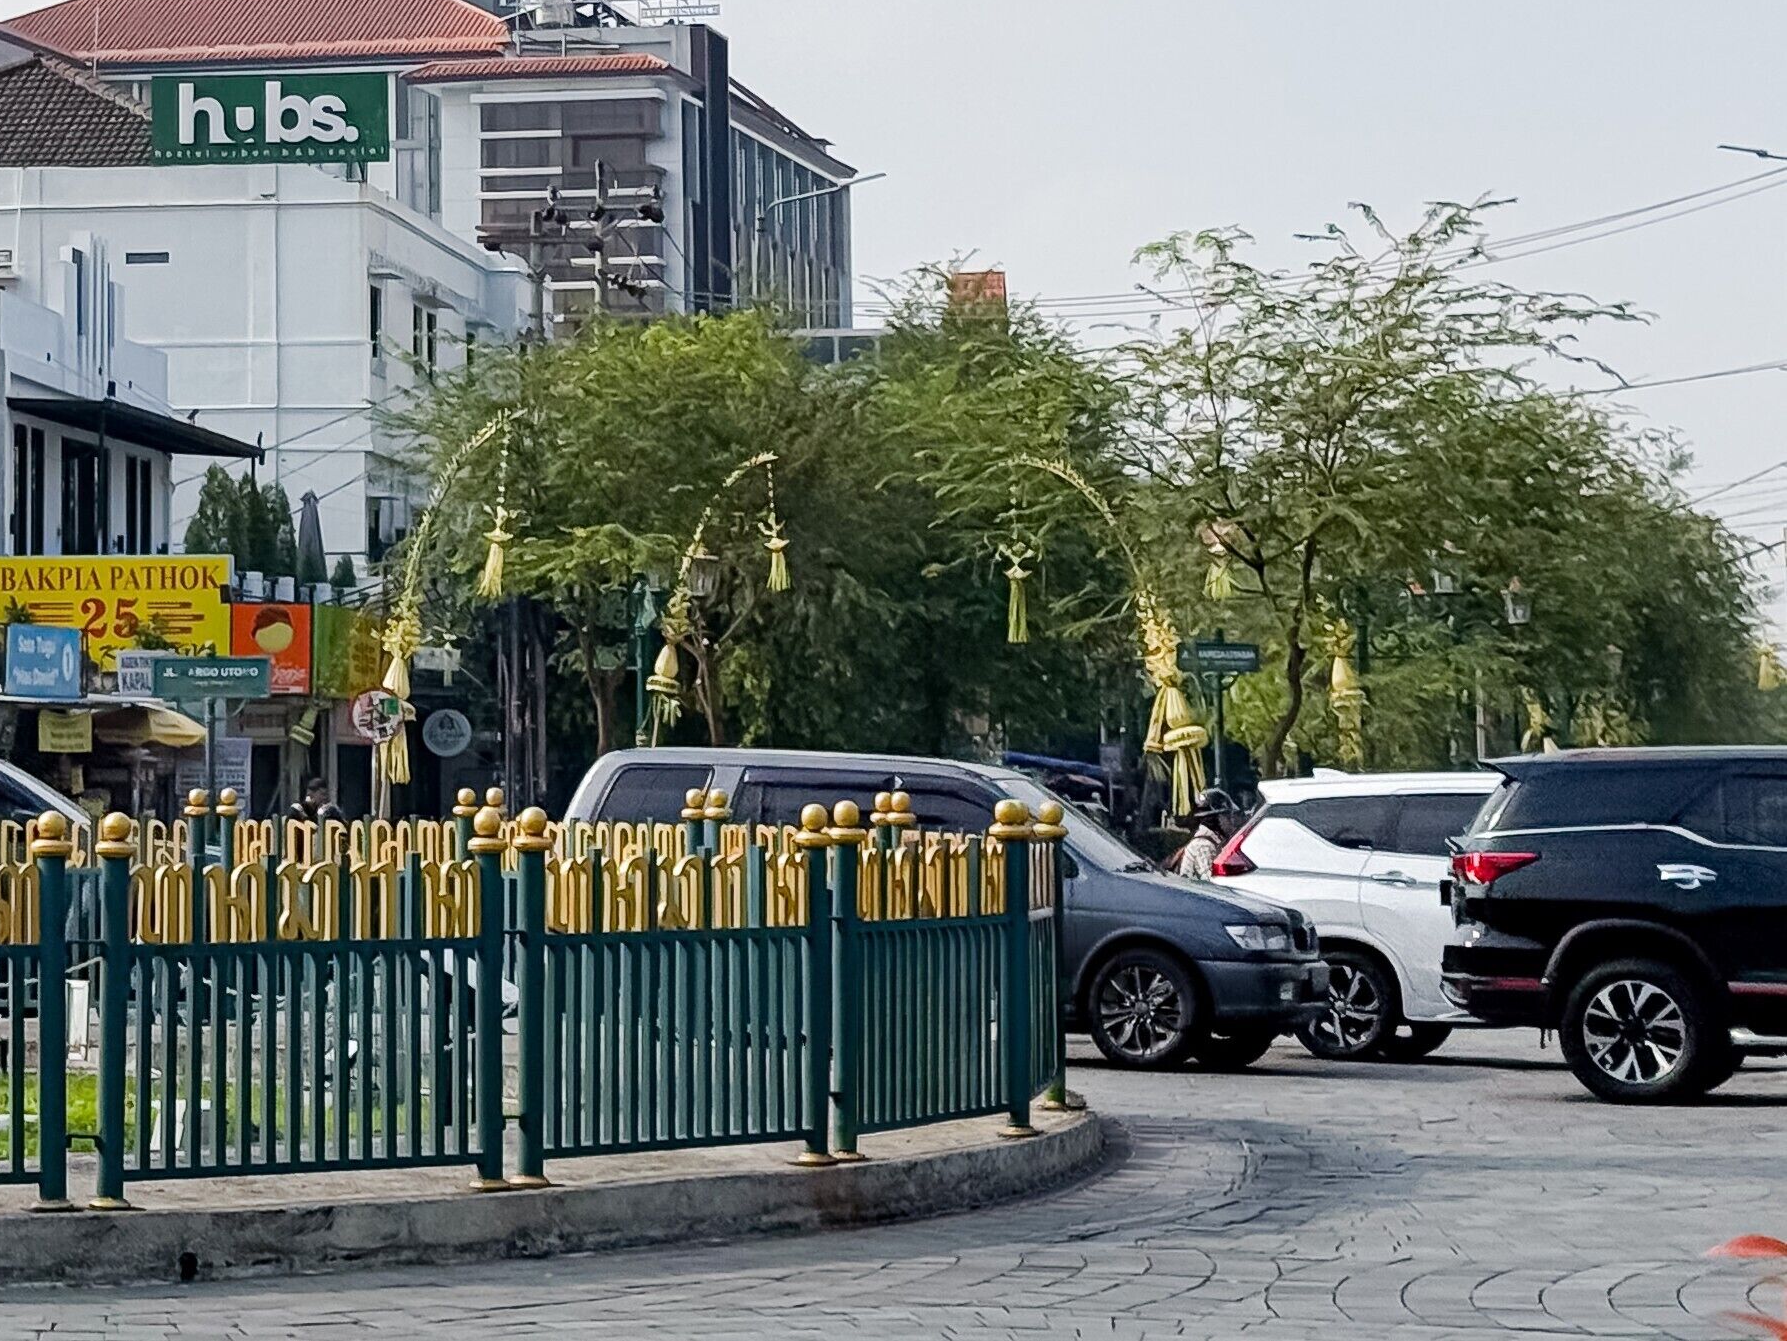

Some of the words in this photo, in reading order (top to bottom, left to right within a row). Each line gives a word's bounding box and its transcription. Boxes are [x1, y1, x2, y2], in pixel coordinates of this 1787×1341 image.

[0, 566, 102, 592] BAKPIA
[111, 565, 221, 591] PATHOK
[80, 597, 139, 639] 25
